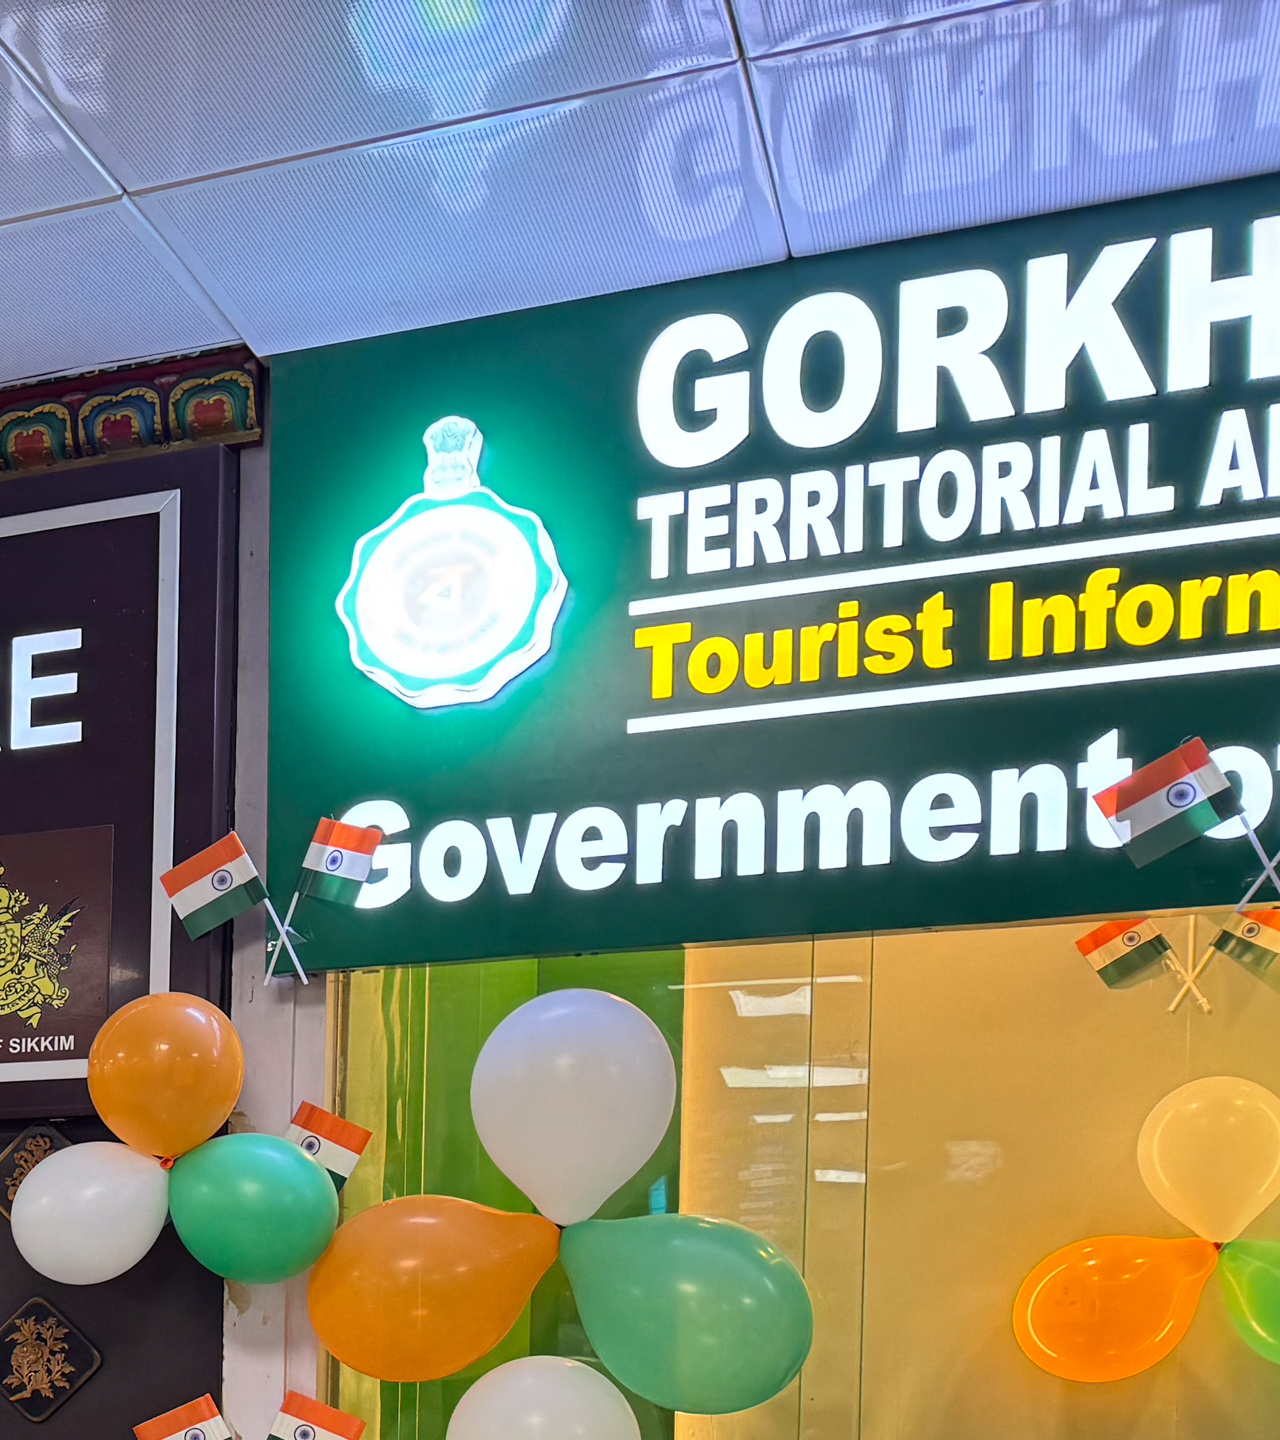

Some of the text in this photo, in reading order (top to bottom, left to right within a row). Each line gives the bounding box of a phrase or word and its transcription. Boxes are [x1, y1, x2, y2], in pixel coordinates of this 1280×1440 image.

[637, 215, 1280, 468] GORKH
[637, 404, 1280, 581] TERRITORIAL A
[634, 590, 954, 700] Tourist
[1204, 743, 1280, 841] o
[8, 1035, 75, 1054] SIKKIM
